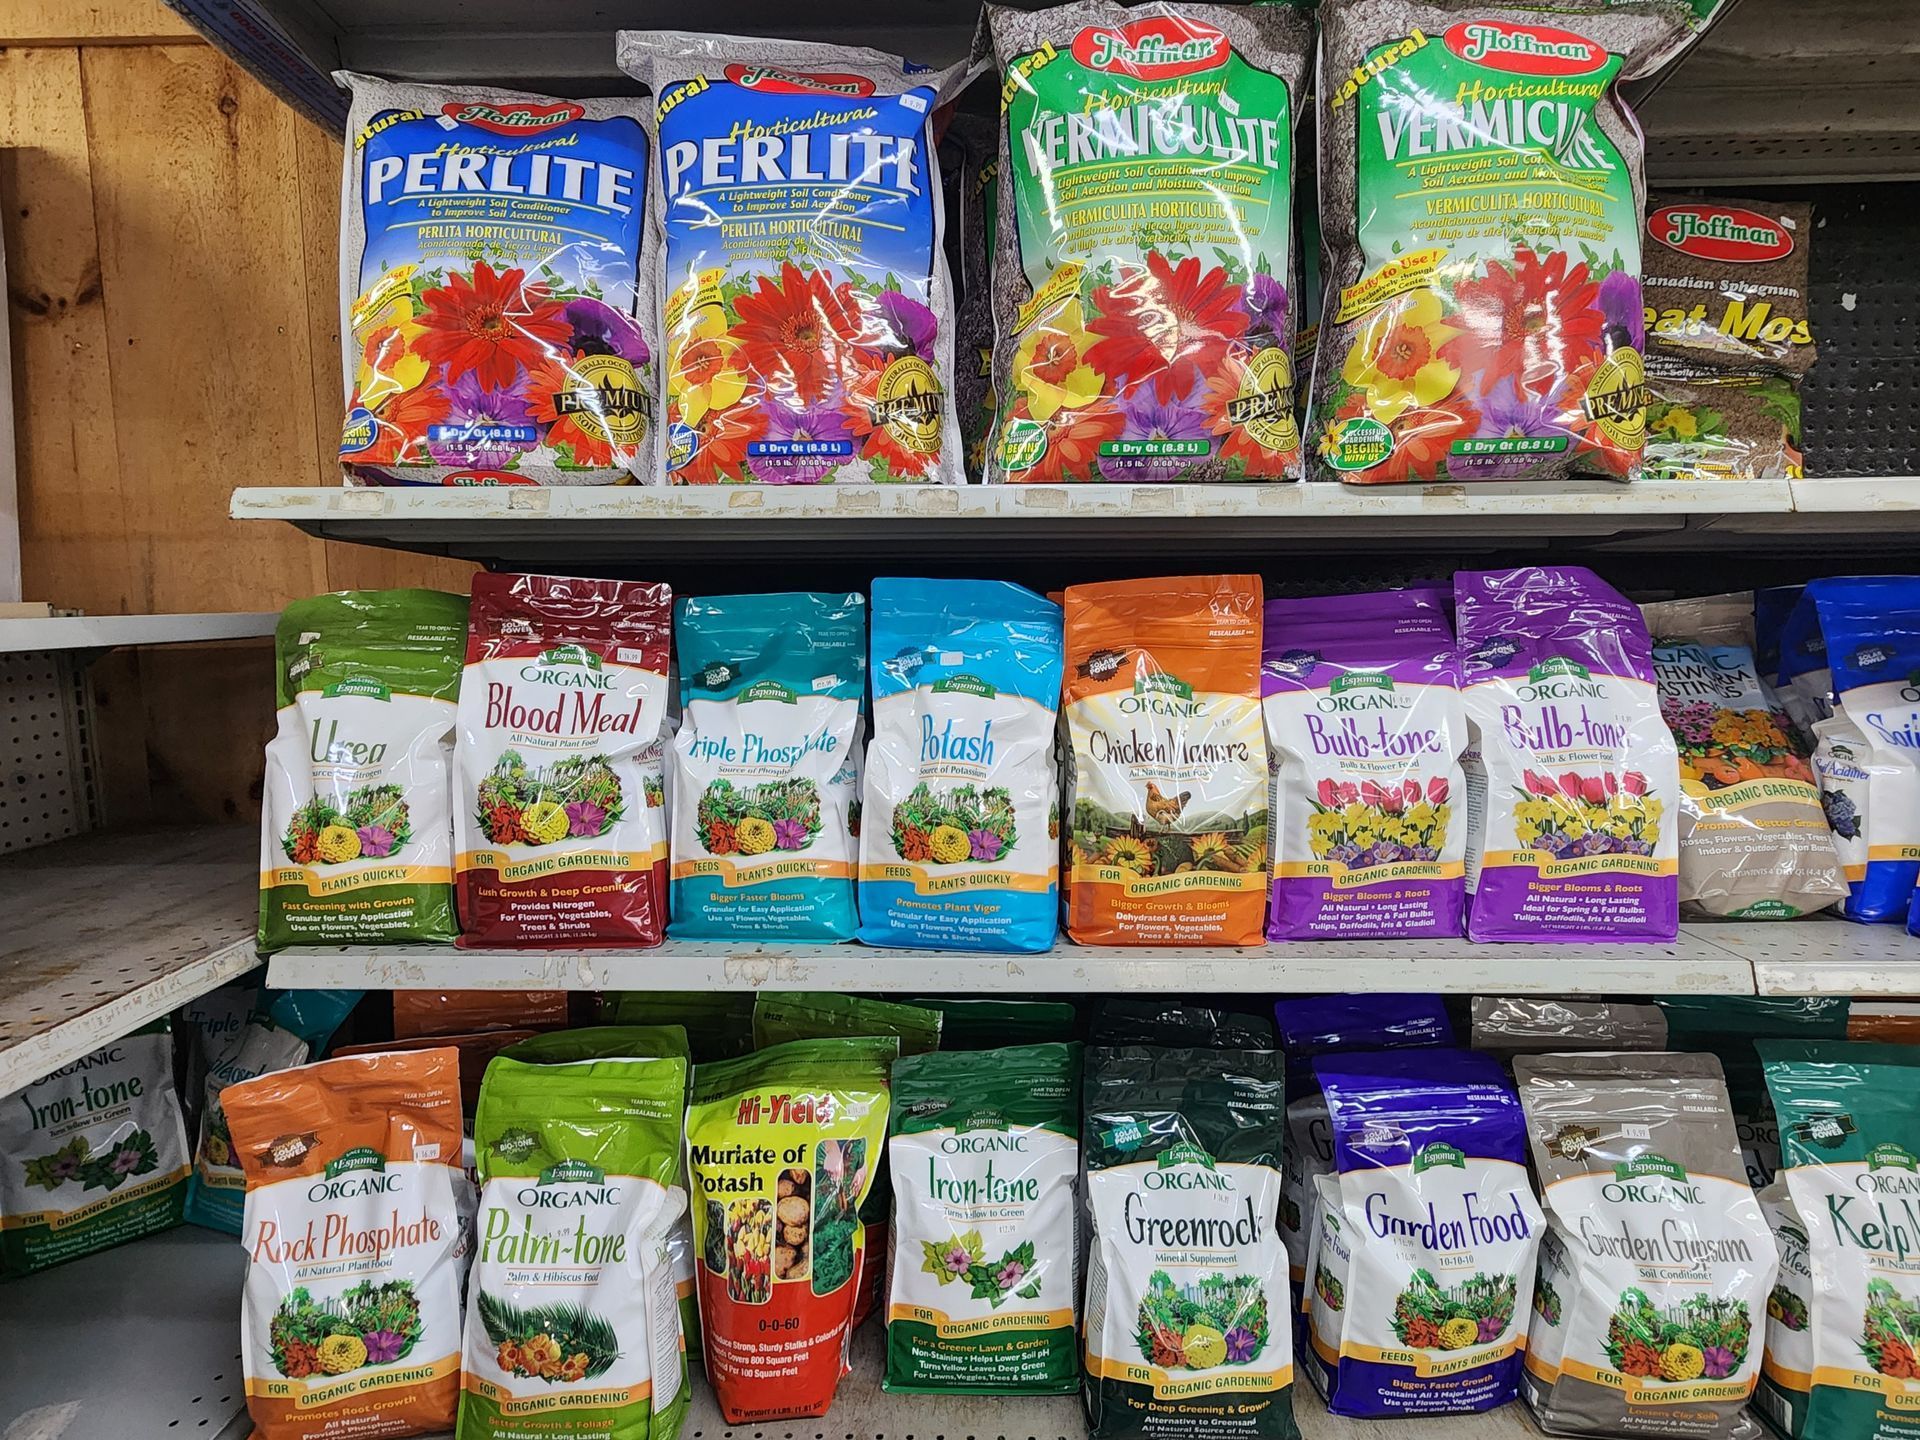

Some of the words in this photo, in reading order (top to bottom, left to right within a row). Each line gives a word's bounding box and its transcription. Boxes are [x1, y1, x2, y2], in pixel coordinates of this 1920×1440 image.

[1093, 34, 1216, 66] Hoffman
[1466, 25, 1589, 60] Hoffman
[741, 66, 859, 94] Hoffman
[1084, 79, 1227, 116] Horticultural
[1456, 79, 1607, 107] Horticultural
[459, 106, 568, 127] Hoffman
[729, 107, 878, 143] Horticultural
[436, 133, 579, 157] Horticultural
[1021, 104, 1279, 177] VERMICULITE
[666, 134, 920, 198] PERLITE
[1421, 159, 1492, 176] Lightweight
[369, 152, 633, 215] PERLITE
[1058, 169, 1121, 189] Lightweight
[1224, 170, 1260, 185] Improve
[1448, 172, 1501, 186] Aeration
[728, 189, 787, 202] Lightweight
[1081, 185, 1129, 197] Aeration
[428, 199, 485, 207] Lightweight
[511, 201, 571, 214] Conditioner
[746, 202, 786, 211] Improve
[1426, 194, 1518, 215] VERMICULITA
[1523, 191, 1604, 217] HORTICULTURAL
[445, 209, 485, 218] Improve
[510, 212, 554, 222] Aeration
[1064, 203, 1146, 227] VERMICULITA
[418, 226, 462, 239] PERLITA
[465, 226, 563, 244] HORTICULTURAL
[1667, 213, 1778, 245] Hoffman
[1346, 278, 1378, 301] Ready
[1640, 275, 1714, 289] Canadian
[1720, 280, 1800, 299] Sphagnum
[1644, 304, 1707, 333] eat
[1719, 301, 1816, 343] Mos
[769, 444, 788, 454] Dry
[1345, 442, 1384, 454] BEGINS
[520, 666, 617, 690] ORGANIC
[945, 681, 986, 692] Espoma
[1342, 676, 1382, 685] Espoma
[337, 685, 381, 694] Espoma
[749, 690, 787, 699] Espoma
[1516, 683, 1609, 702] ORGANIC
[486, 683, 565, 734] Blood
[571, 692, 642, 735] Meal
[1119, 697, 1209, 718] ORGANIC
[311, 717, 387, 765] Urea
[525, 737, 557, 747] Natural
[560, 738, 579, 747] Plant
[921, 714, 994, 765] Potash
[1090, 728, 1165, 764] Chicken
[1304, 714, 1443, 758] Bulb-tone
[1569, 753, 1598, 762] Flower
[951, 766, 987, 778] Potassium
[1705, 782, 1761, 808] ORGANIC
[1698, 846, 1731, 855] Indoor
[1745, 844, 1778, 853] Outdoor
[476, 855, 493, 864] FOR
[505, 859, 553, 877] ORGANIC
[558, 855, 629, 867] GARDENING
[694, 862, 719, 872] FEEDS
[737, 867, 772, 882] PLANTS
[777, 862, 816, 873] QUICKLY
[1513, 853, 1535, 862] FOR
[1546, 861, 1597, 874] ORGANIC
[1602, 859, 1659, 871] GARDENING
[280, 872, 303, 881] FEEDS
[322, 876, 359, 891] PLANTS
[364, 869, 408, 881] QUICKLY
[886, 867, 911, 876] FEEDS
[929, 877, 965, 890] PLANTS
[970, 874, 1011, 885] QUICKLY
[1100, 870, 1120, 880] FOR
[1131, 879, 1181, 893] ORGANIC
[1184, 876, 1242, 887] GARDENING
[1307, 865, 1328, 873] FOR
[1340, 871, 1387, 884] ORGANIC
[1391, 866, 1441, 875] GARDENING
[1529, 882, 1560, 892] Bigger
[1565, 884, 1601, 892] Blooms
[303, 903, 345, 911] Greening
[374, 897, 414, 908] Growth
[552, 901, 594, 910] Nitrogen
[897, 898, 941, 910] Promotes
[945, 903, 970, 912] Plant
[973, 904, 1001, 914] Vigor
[1609, 897, 1639, 905] Lasting
[360, 911, 413, 920] Application
[1116, 912, 1167, 922] Dehydrated
[1179, 913, 1226, 922] Granulated
[21, 1076, 143, 1130] Iron-tone
[737, 1094, 834, 1125] Hi-Yield
[692, 1145, 775, 1165] Muriate
[783, 1144, 807, 1163] of
[941, 1136, 1028, 1153] ORGANIC
[338, 1157, 378, 1170] Espoma
[1424, 1152, 1455, 1163] Espoma
[1629, 1162, 1674, 1173] Espoma
[1875, 1152, 1910, 1163] Espoma
[551, 1168, 593, 1179] Espoma
[928, 1156, 1039, 1203] Iron-tone
[1144, 1171, 1235, 1191] ORGANIC
[308, 1174, 402, 1203] ORGANIC
[518, 1188, 620, 1208] ORGANIC
[1602, 1184, 1705, 1204] ORGANIC
[57, 1202, 107, 1226] ORGANIC
[111, 1177, 171, 1204] GARDENING
[1125, 1192, 1263, 1247] Greenrock
[1365, 1193, 1466, 1250] Garden
[1463, 1192, 1531, 1245] Food
[1825, 1193, 1911, 1261] Kelp
[253, 1220, 317, 1263] Rock
[322, 1206, 440, 1260] Phosphate
[482, 1208, 626, 1264] Palm-tone
[1580, 1216, 1660, 1262] Garden
[1662, 1219, 1752, 1271] Gypsum
[1155, 1252, 1187, 1262] Mineral
[1190, 1253, 1237, 1265] Supplement
[1440, 1256, 1474, 1266] 10-10-10
[310, 1263, 345, 1277] Natural
[543, 1272, 581, 1281] Hibiscus
[759, 1317, 799, 1331] 0-0-60
[915, 1309, 932, 1319] FOR
[943, 1321, 989, 1333] ORGANIC
[993, 1315, 1049, 1327] GARDENING
[759, 1343, 782, 1352] Sturdy
[912, 1348, 962, 1363] Non-Staining
[938, 1342, 975, 1352] Greener
[1017, 1339, 1049, 1350] Garden
[766, 1355, 791, 1365] Square
[1381, 1351, 1414, 1362] FEEDS
[1431, 1359, 1467, 1373] PLANTS
[1471, 1349, 1504, 1363] QUICKLY
[268, 1384, 289, 1394] FOR
[302, 1383, 355, 1404] ORGANIC
[359, 1368, 433, 1388] GARDENING
[1128, 1368, 1149, 1380] FOR
[1162, 1380, 1211, 1394] ORGANIC
[1216, 1376, 1273, 1387] GARDENING
[1597, 1372, 1623, 1385] FOR
[1634, 1390, 1689, 1400] ORGANIC
[1692, 1386, 1746, 1398] GARDENING
[1854, 1375, 1881, 1388] FOR
[507, 1398, 555, 1412] ORGANIC
[560, 1392, 628, 1405] GARDENING
